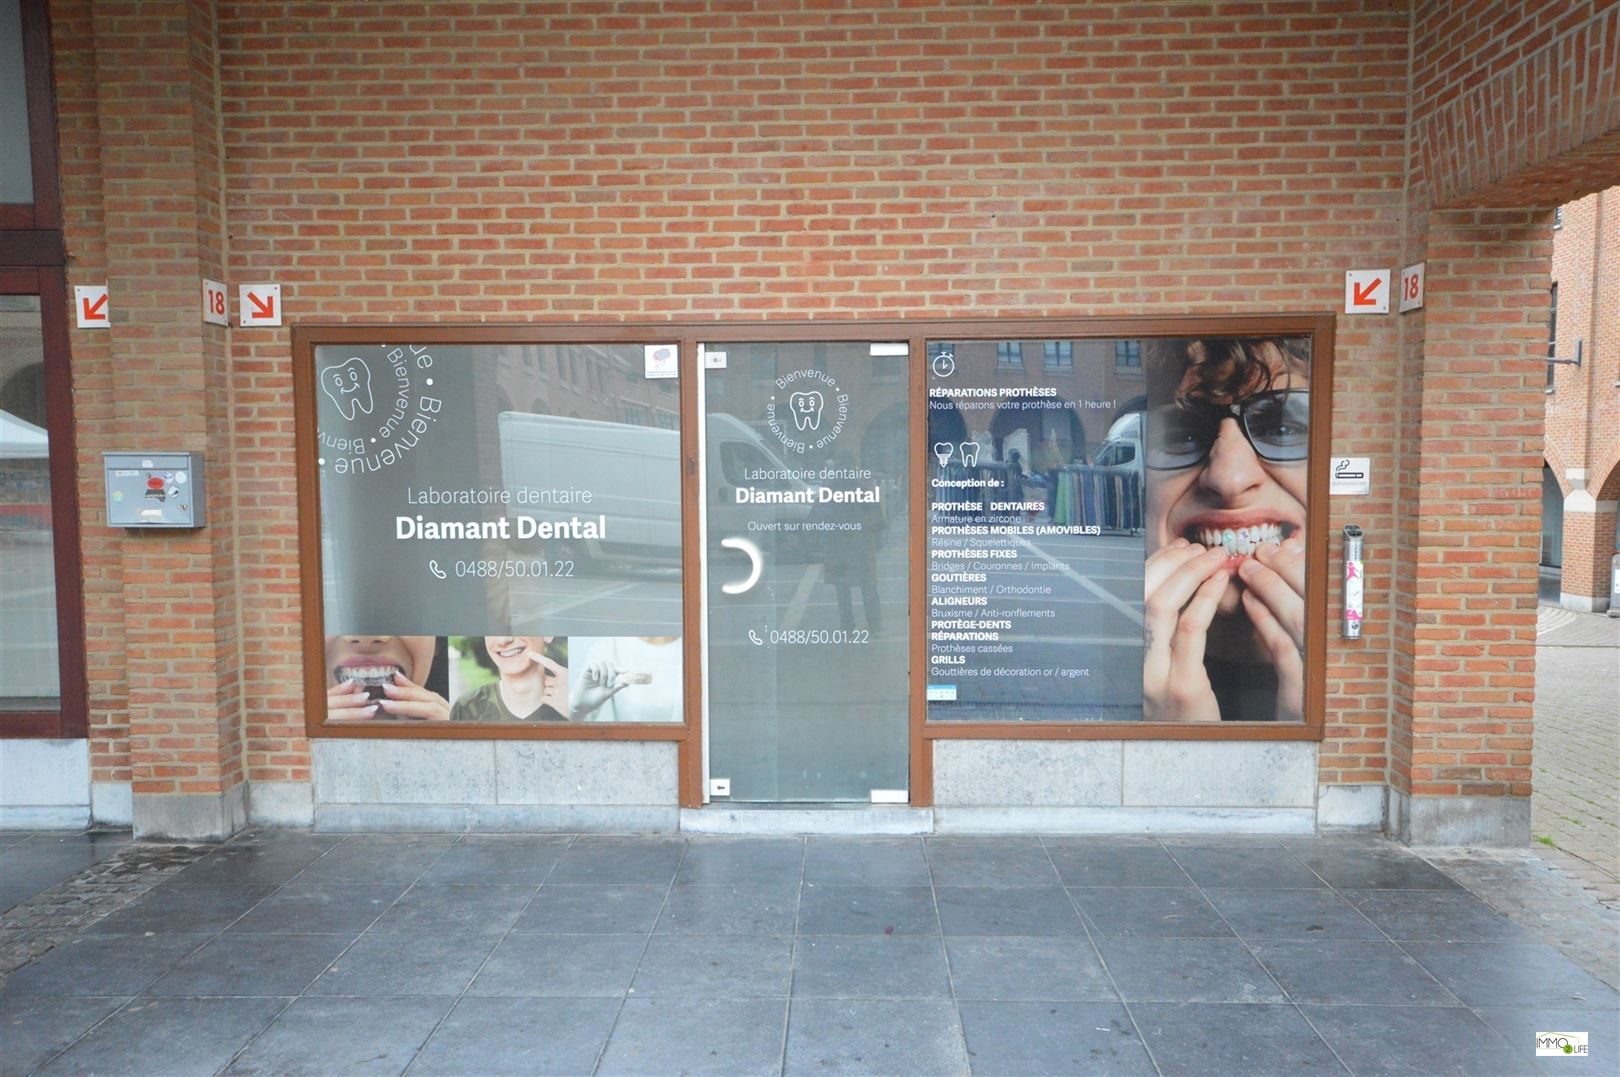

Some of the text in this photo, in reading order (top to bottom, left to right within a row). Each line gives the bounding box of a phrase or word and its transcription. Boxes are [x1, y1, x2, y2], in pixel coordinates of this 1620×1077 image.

[1405, 273, 1418, 301] 18
[209, 289, 225, 315] 18
[775, 369, 835, 389] Bienvenue
[379, 347, 410, 438] Bienvenue
[929, 387, 1056, 398] RÉPARATIONS PROTHÈSES
[929, 402, 953, 410] Nous
[956, 401, 995, 410] réparons
[1022, 401, 1061, 410] prothèse
[817, 393, 848, 449] Bienvenue
[767, 403, 804, 454] Bienvenue
[335, 396, 441, 474] Bienvenue
[744, 467, 871, 480] Laboratoire dentaire
[932, 479, 985, 489] Conception
[988, 479, 999, 487] de
[408, 487, 592, 504] Laboratoire dentaire
[736, 486, 880, 503] Diamant Dental
[931, 501, 1044, 512] PROTHÈSE DENTAIRES
[931, 515, 972, 523] Armature
[988, 515, 1021, 523] zircone
[396, 515, 606, 540] Diamant Dental
[748, 521, 862, 530] Ouvert sur rendez-vous
[931, 524, 1100, 536] PROTHÈSES MOBILES (AMOVIBLES)
[931, 538, 962, 547] Résine
[931, 548, 1018, 559] PROTHÈSES FIXES
[455, 560, 575, 578] 0488/50.01.22
[931, 562, 965, 571] Bridges
[973, 562, 1022, 570] Couronnes
[1031, 562, 1070, 571] Implants
[931, 571, 987, 582] GOUTIÈRES
[931, 586, 987, 594] Blanchiment
[996, 586, 1051, 594] Orthodontie
[931, 597, 987, 606] ALIGNEURS
[931, 609, 972, 618] Bruxisme
[981, 609, 1055, 618] Anti-ronflements
[931, 619, 1011, 629] PROTÈGE-DENTS
[770, 630, 869, 644] 0488/50.01.22
[931, 630, 999, 641] RÉPARATIONS
[931, 644, 1013, 652] Prothèses cassées
[931, 655, 965, 664] GRILLS
[931, 667, 978, 676] Gouttières
[980, 668, 991, 676] de
[994, 667, 1041, 676] décoration
[1061, 668, 1090, 678] argent
